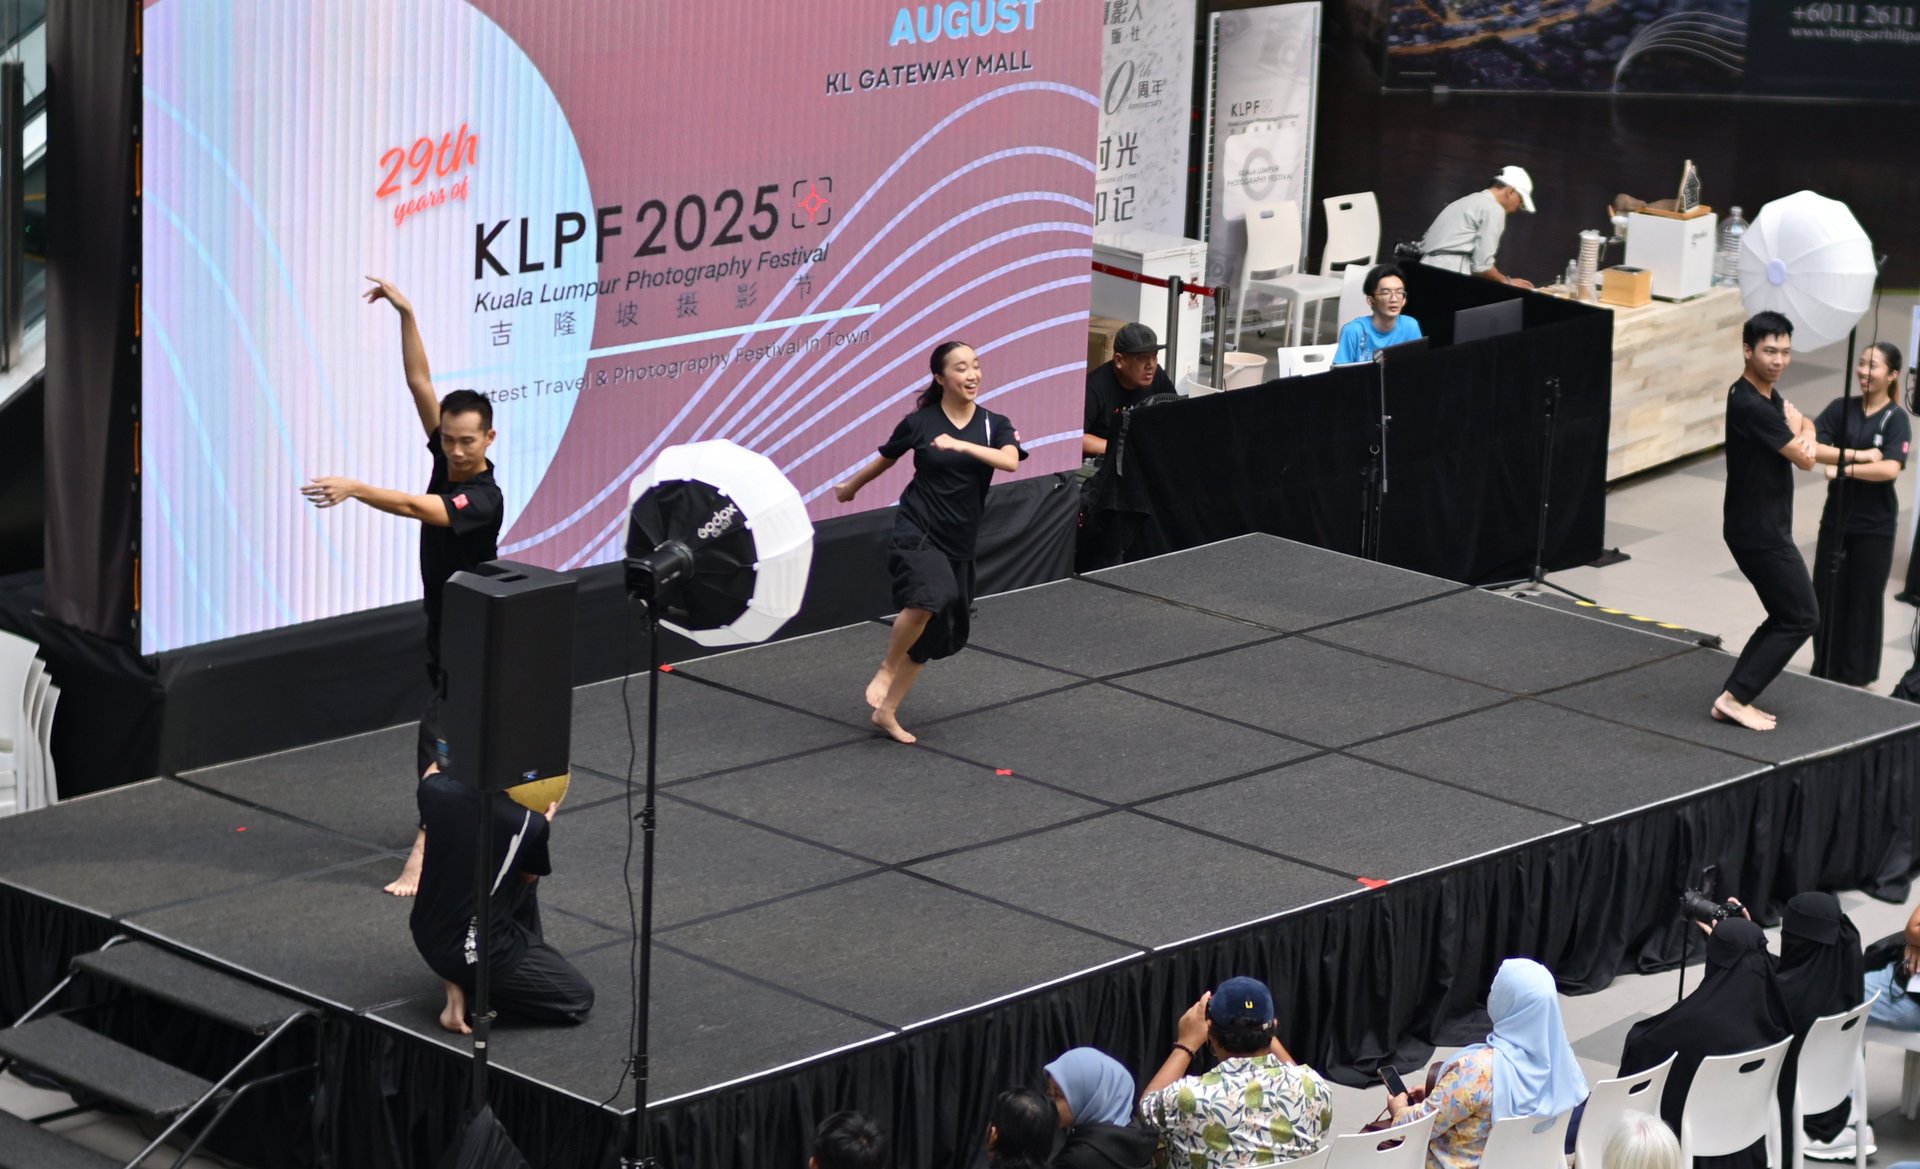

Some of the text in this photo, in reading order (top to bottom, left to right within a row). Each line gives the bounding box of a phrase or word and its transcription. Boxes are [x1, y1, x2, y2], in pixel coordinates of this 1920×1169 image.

[889, 0, 1040, 46] AUGUST
[1792, 3, 1914, 26] +6011 2611
[826, 50, 1032, 95] KL GATEWAY MALL
[1230, 100, 1260, 117] KLPF
[376, 122, 477, 199] 29th
[394, 174, 469, 228] years of
[475, 184, 779, 280] KLPF 2025
[474, 242, 830, 313] Kuala Lumpur Photography Festival
[534, 372, 592, 396] Travel
[596, 369, 608, 386] &
[613, 351, 731, 384] Photography
[735, 336, 801, 364] Festival
[805, 337, 819, 353] in
[826, 328, 871, 348] Town
